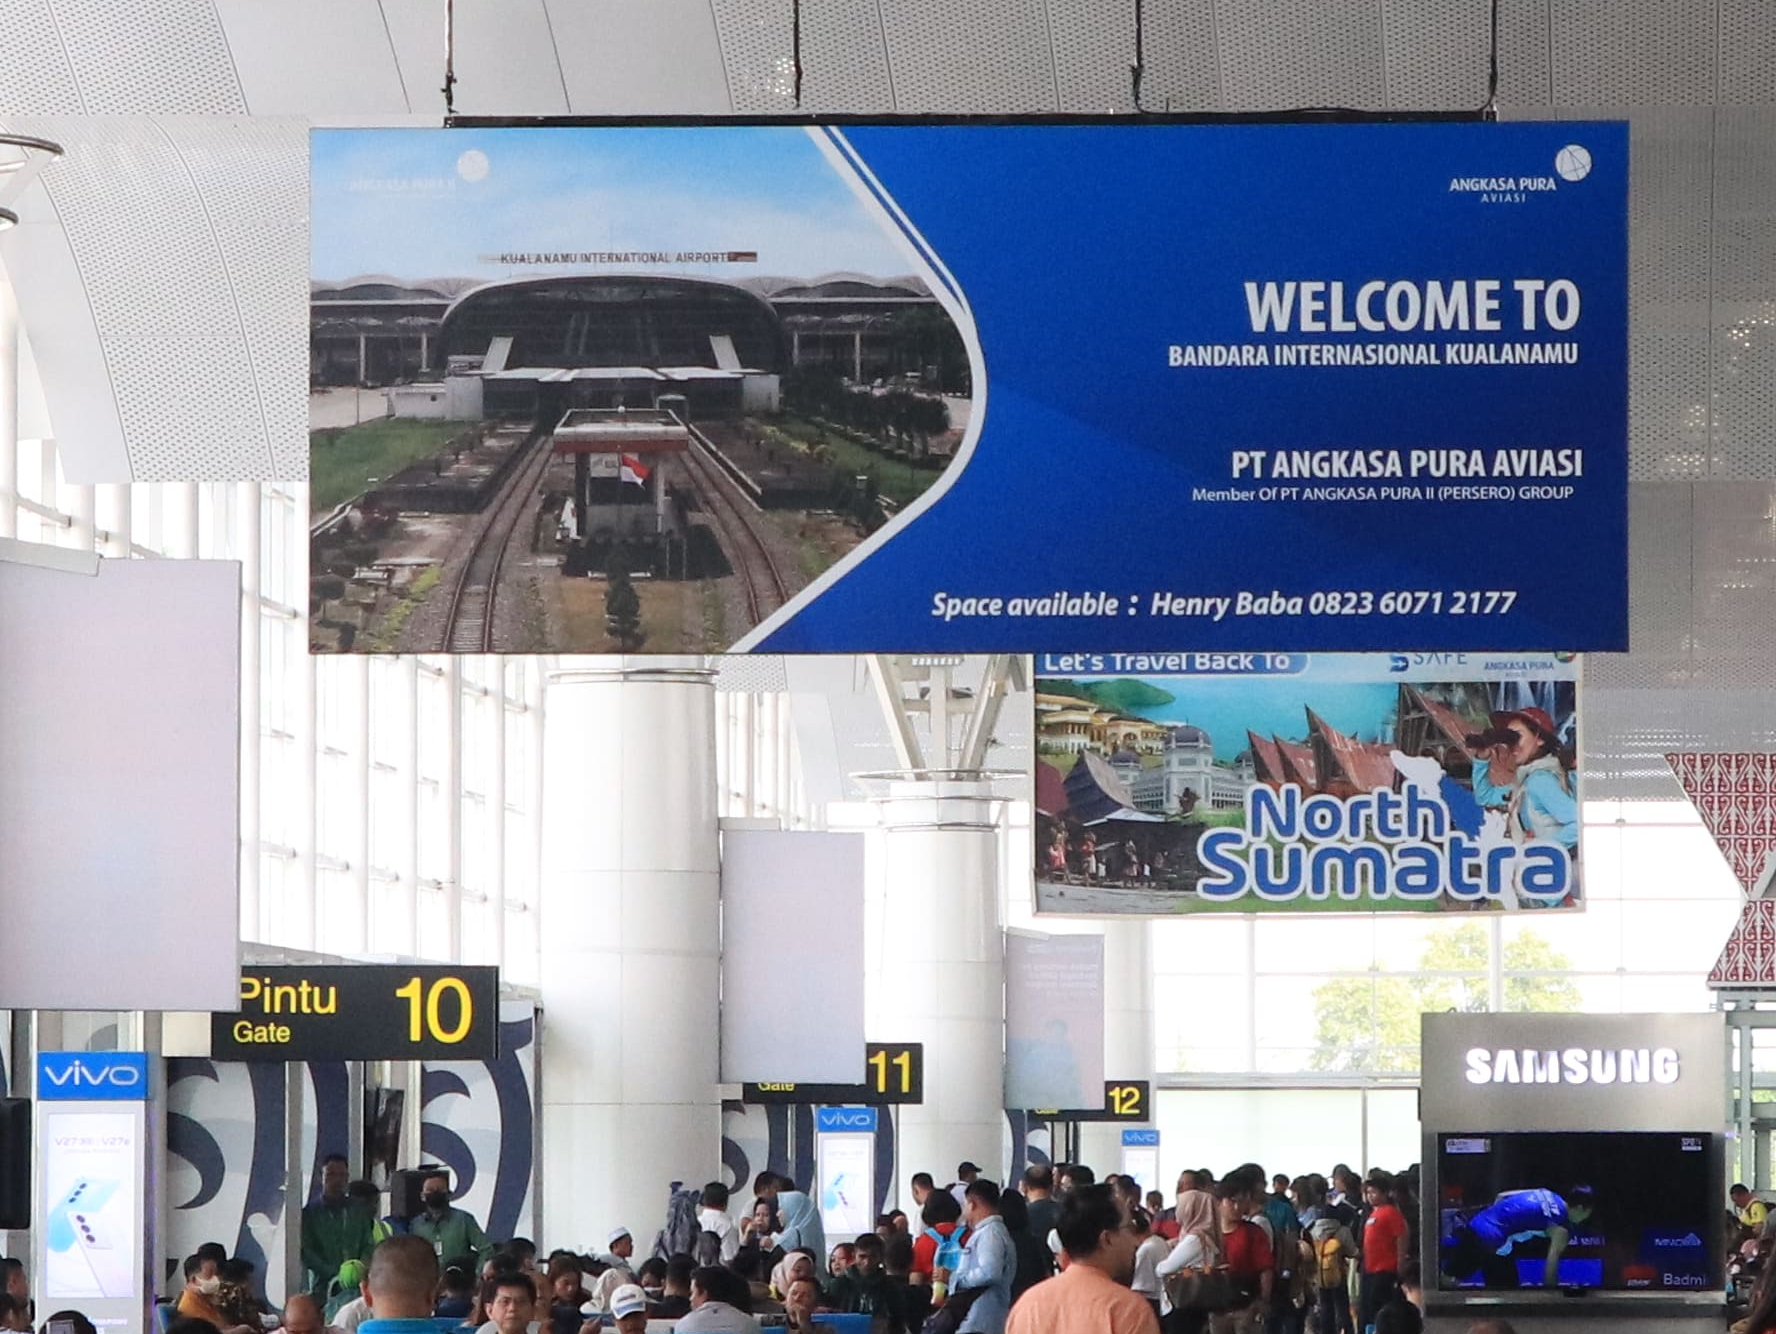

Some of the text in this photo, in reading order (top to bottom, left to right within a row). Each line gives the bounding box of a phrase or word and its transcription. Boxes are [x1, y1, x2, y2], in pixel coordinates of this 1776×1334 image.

[1449, 177, 1557, 192] ANGKASA PURA
[1480, 192, 1526, 203] AVIASI
[500, 251, 727, 265] KUALANAMU INTERNATIONAL AIRPORT
[1244, 279, 1581, 333] WELCOME TO
[1168, 342, 1578, 367] BANDARA INTERNASIONAL KUALANAMU
[1232, 448, 1583, 479] PT ANGKASA PURA AVIASI
[1192, 485, 1574, 502] Member Of PT ANGKASA PURA II (PERSERO) GROUP
[931, 592, 1003, 622] Space
[1006, 591, 1119, 616] available
[1150, 592, 1231, 622] Henry
[1235, 590, 1304, 616] Baba
[1308, 591, 1374, 615] 0823
[1379, 591, 1443, 615] 6071
[1448, 591, 1517, 614] 2177
[1045, 652, 1291, 673] Let's Travel Back To
[1249, 782, 1447, 840] North
[1200, 831, 1570, 898] Sumatra
[240, 976, 474, 1044] Pintu 10
[233, 1021, 291, 1044] Gate
[43, 1058, 139, 1087] vivo
[869, 1050, 911, 1093] 11
[1465, 1047, 1681, 1085] SAMSUNG
[1109, 1086, 1141, 1114] 12
[821, 1112, 871, 1126] vivo
